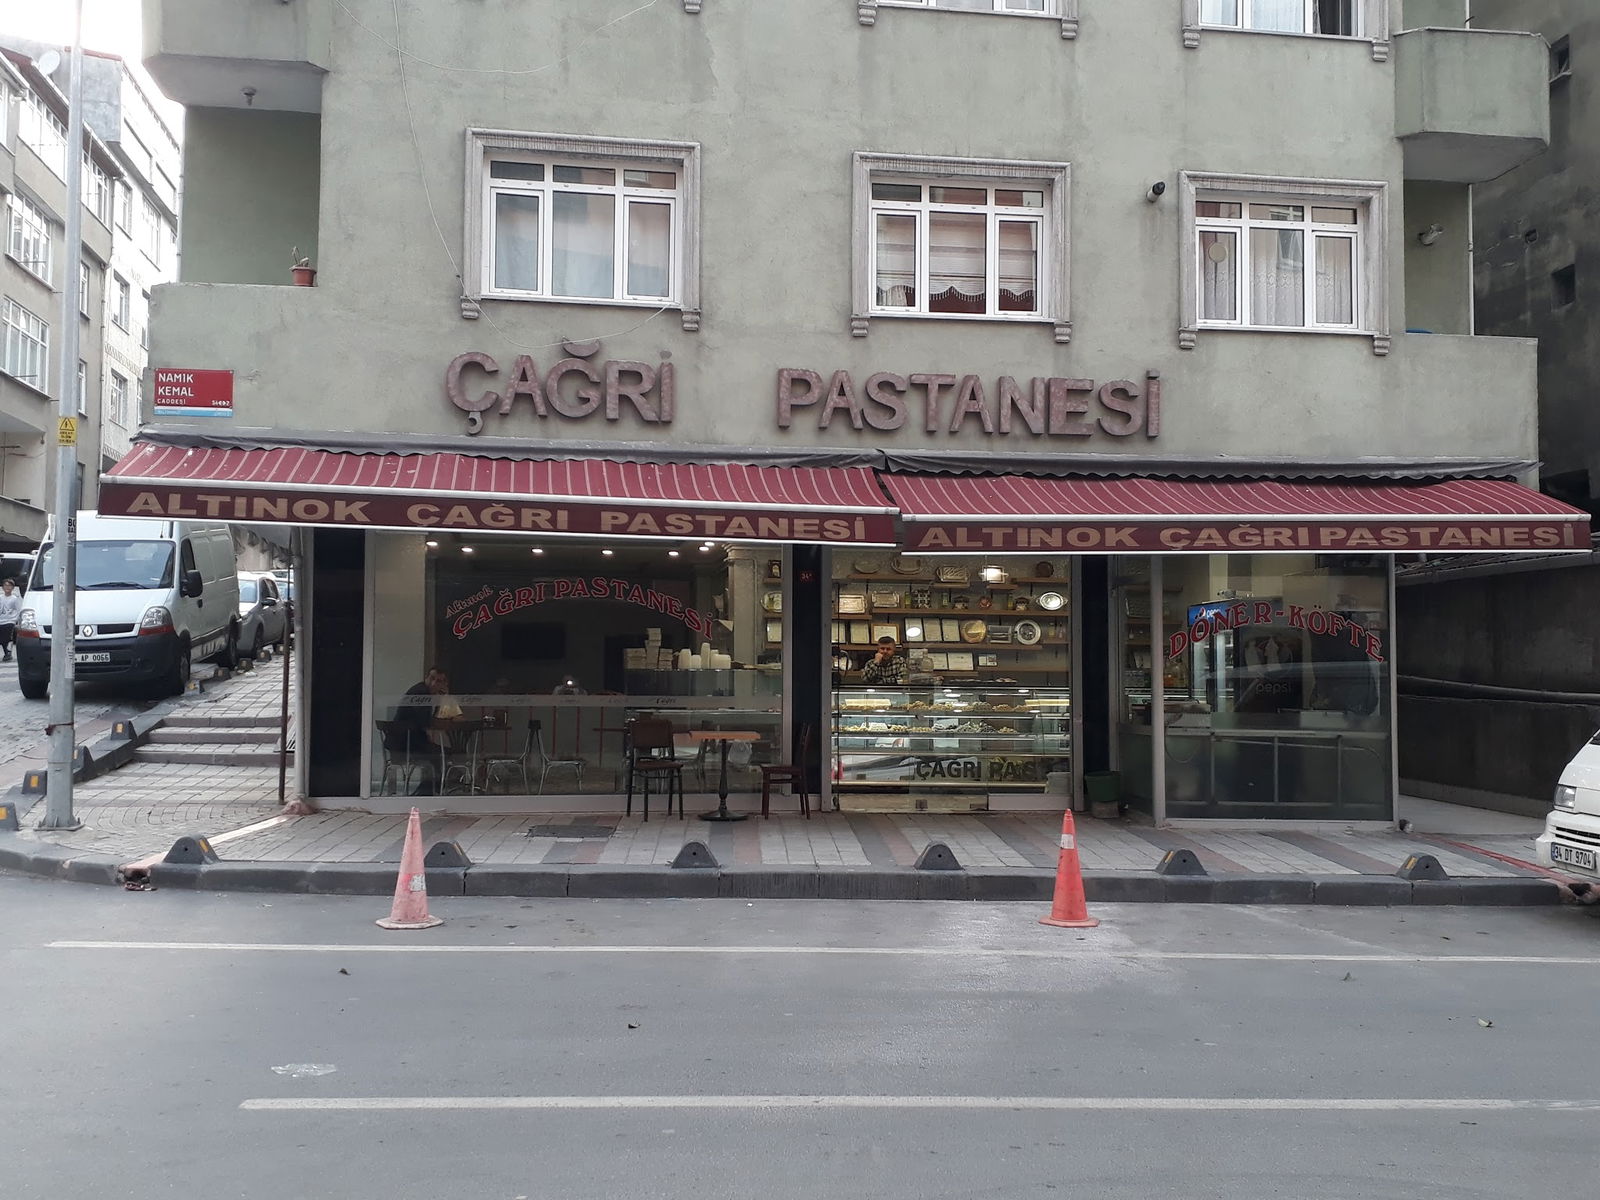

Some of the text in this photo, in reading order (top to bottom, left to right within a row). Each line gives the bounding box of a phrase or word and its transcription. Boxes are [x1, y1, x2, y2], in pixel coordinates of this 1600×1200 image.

[158, 373, 193, 383] NAMIK
[158, 386, 194, 397] KEMAL
[777, 368, 1160, 437] PASTANESİ
[126, 491, 866, 540] ALTINOK ÇAĞRI PASTANESİ
[918, 523, 1575, 550] ALTINOK ÇAĞRI PASTANESİ
[452, 577, 714, 640] ÇAĞRI PASTANESİ
[1554, 846, 1562, 860] 34
[1565, 849, 1573, 861] DT
